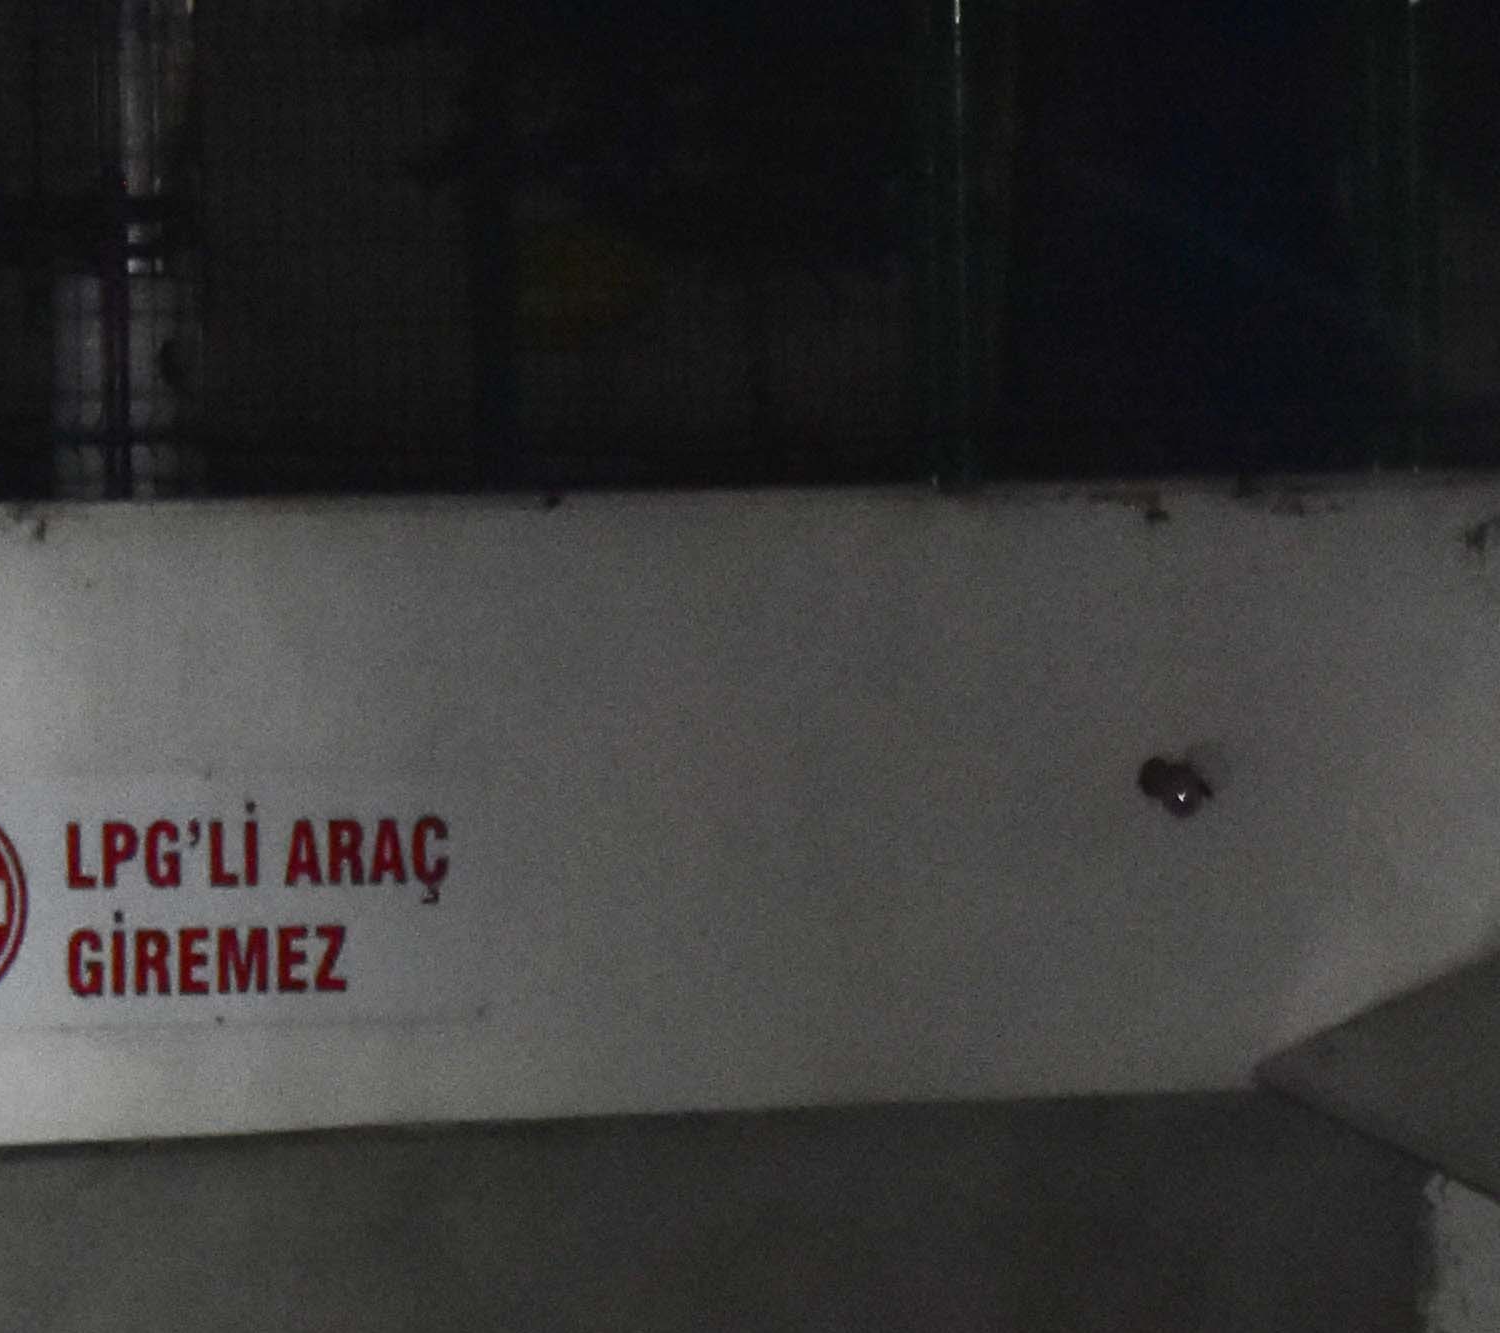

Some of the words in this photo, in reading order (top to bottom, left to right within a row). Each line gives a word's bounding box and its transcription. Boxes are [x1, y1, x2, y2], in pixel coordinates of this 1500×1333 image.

[65, 801, 260, 889] LPG'Lİ
[284, 814, 450, 904] ARAÇ
[67, 911, 347, 997] GİREMEZ
